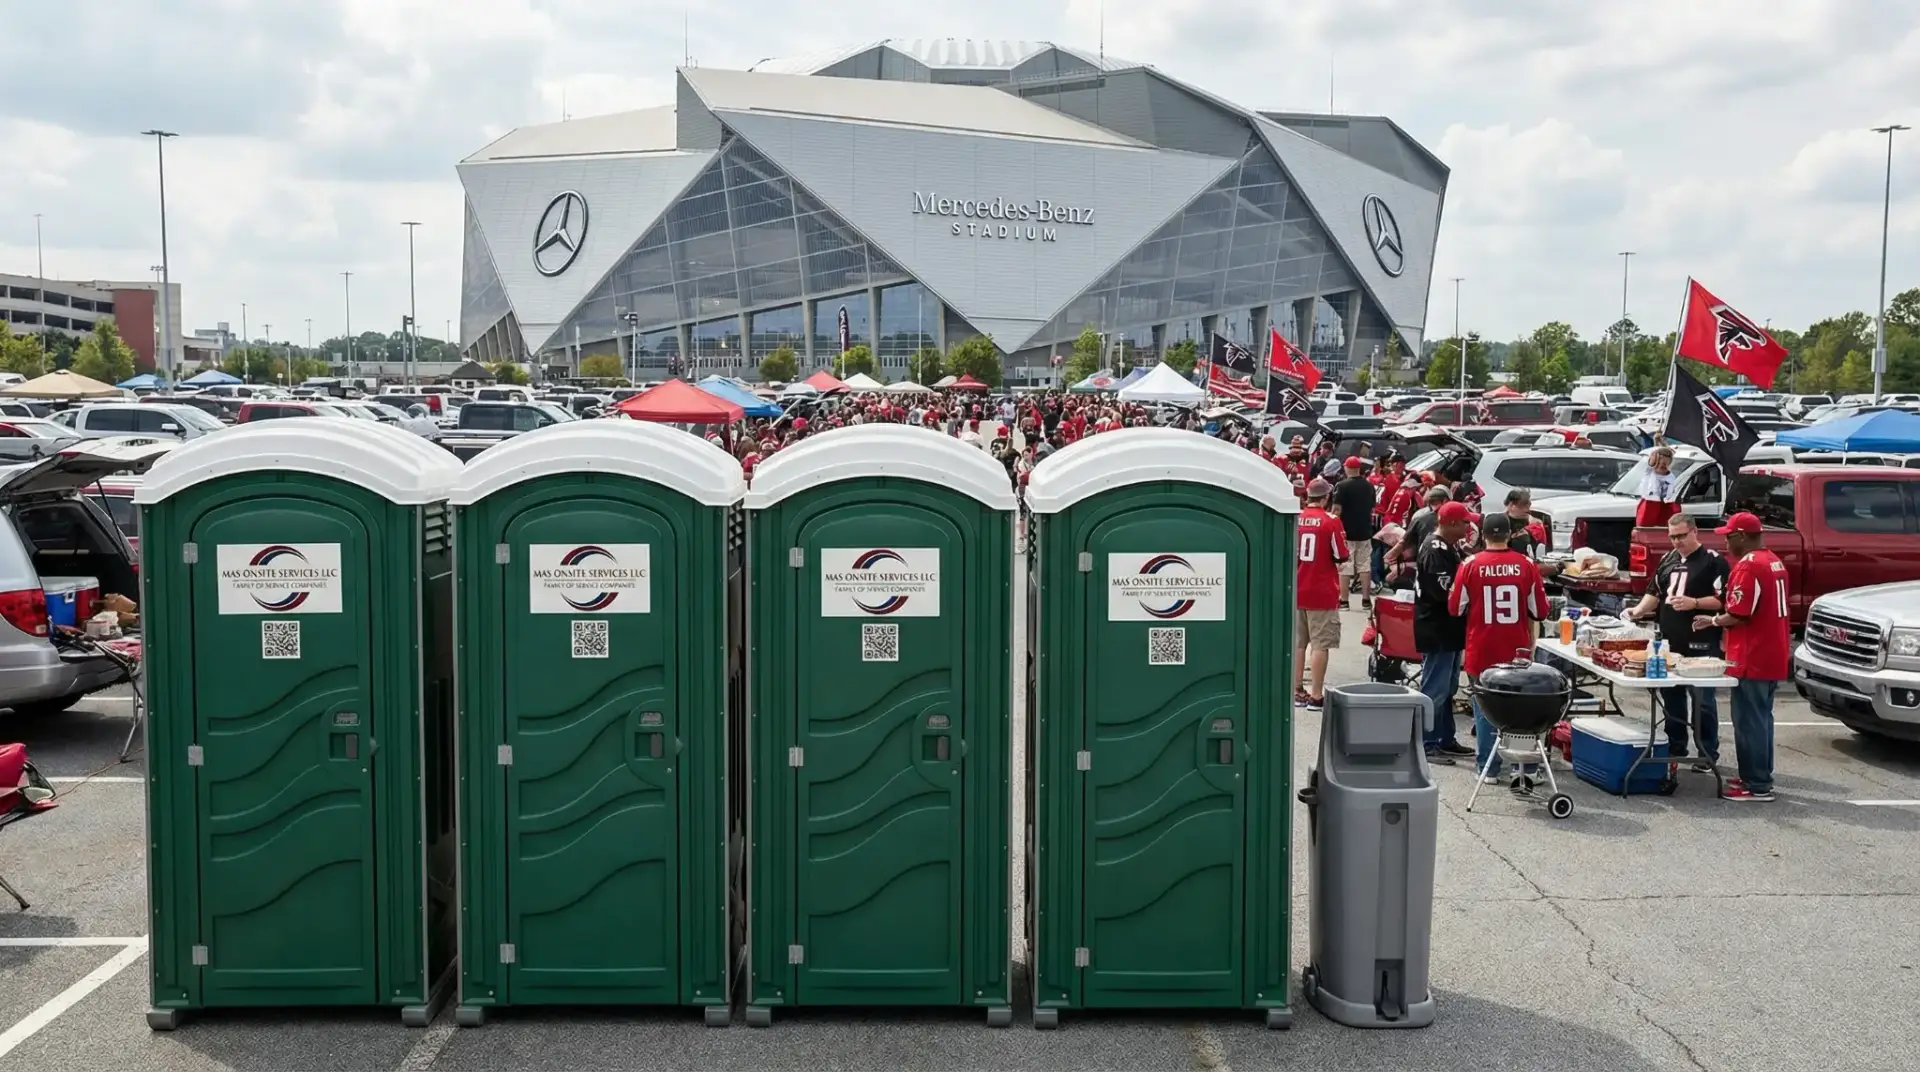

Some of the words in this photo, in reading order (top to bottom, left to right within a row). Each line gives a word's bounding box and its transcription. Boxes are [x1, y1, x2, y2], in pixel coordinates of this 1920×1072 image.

[912, 191, 1095, 225] Mercedes-Benz
[951, 222, 1057, 242] STADIUM
[222, 569, 241, 578] MAS
[243, 569, 276, 578] ONSITE
[279, 568, 319, 577] SERVICES
[321, 568, 338, 577] LLC
[533, 569, 552, 578] MAS
[554, 569, 586, 578] ONSITE
[589, 569, 628, 578] SERVICES
[630, 569, 646, 578] LLC
[825, 573, 843, 581] MAS
[845, 573, 877, 581] ONSITE
[880, 573, 919, 581] SERVICES
[921, 573, 936, 581] LLC
[1479, 564, 1521, 577] FALCONS
[1112, 578, 1130, 586] MAS
[1132, 577, 1163, 586] ONSITE
[1166, 577, 1204, 586] SERVICES
[1206, 577, 1222, 586] LLC
[1483, 584, 1519, 625] 19
[1775, 579, 1787, 618] 11
